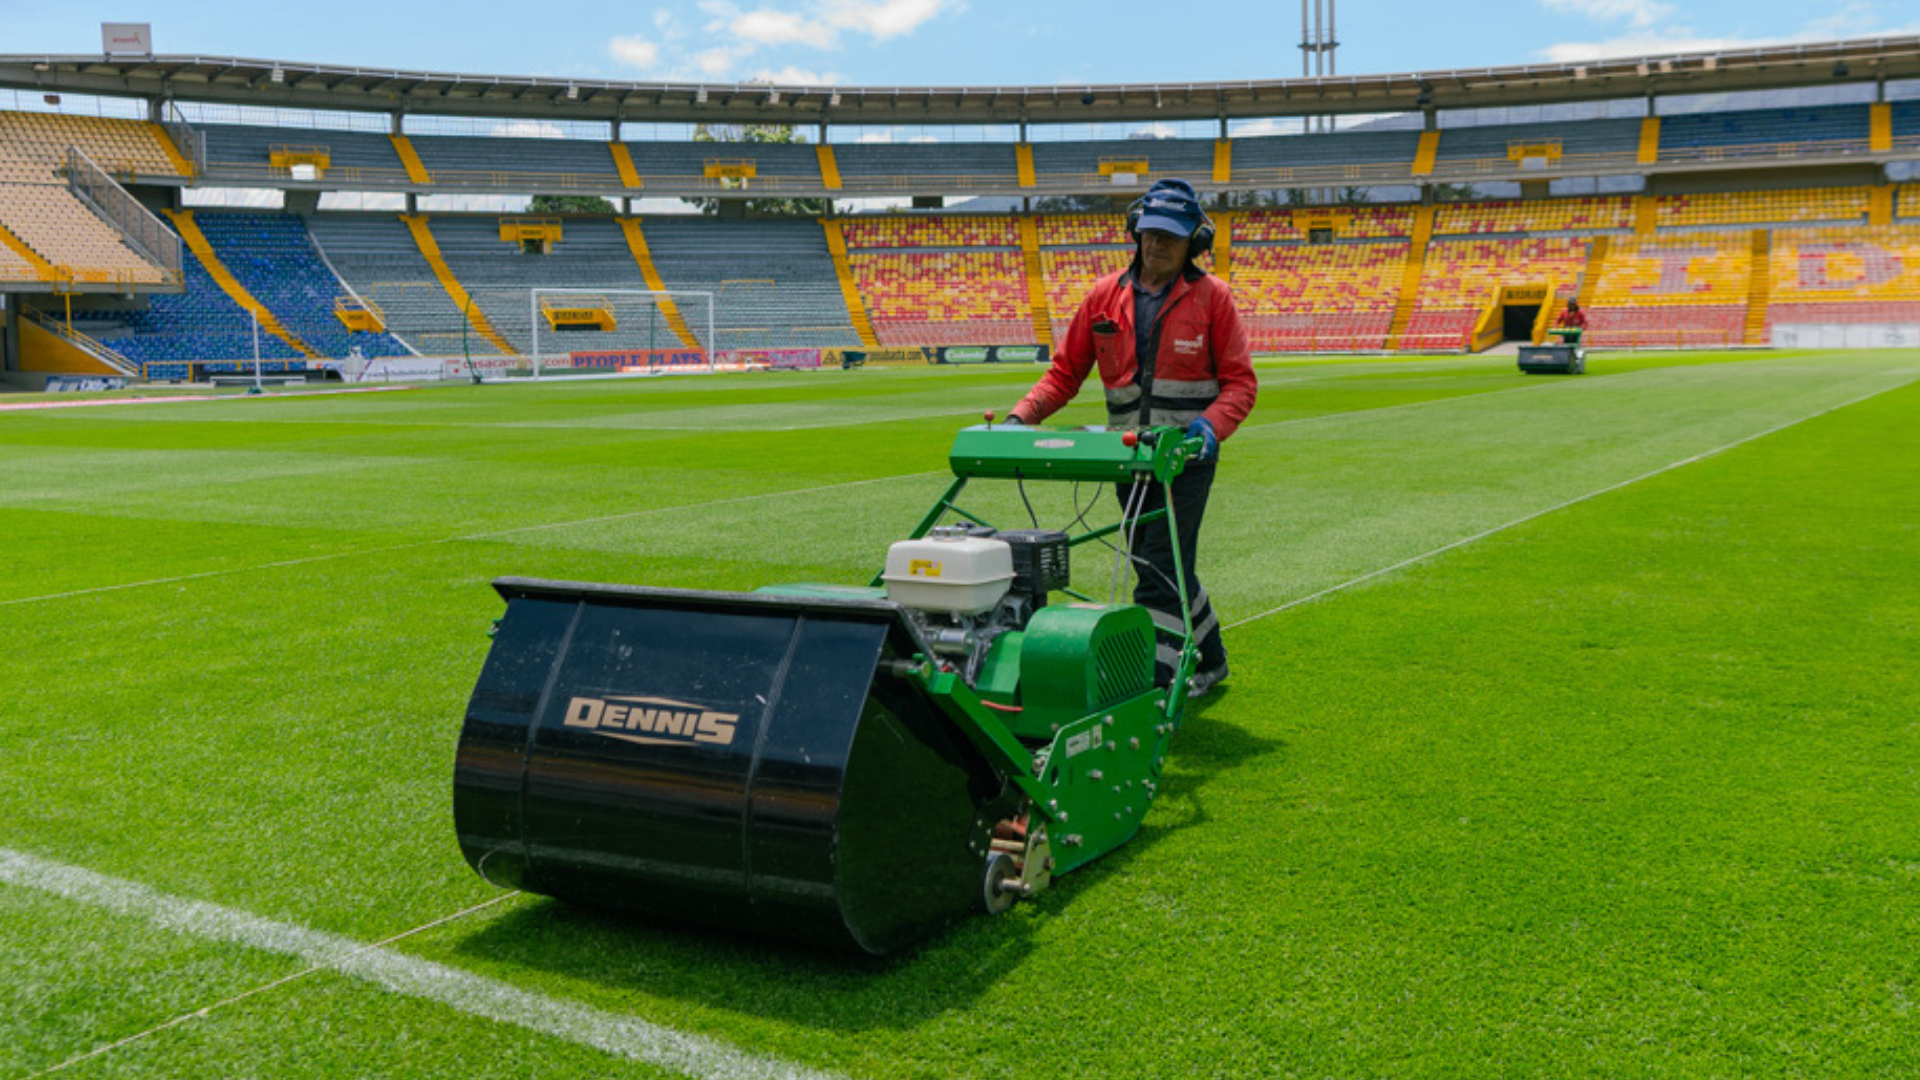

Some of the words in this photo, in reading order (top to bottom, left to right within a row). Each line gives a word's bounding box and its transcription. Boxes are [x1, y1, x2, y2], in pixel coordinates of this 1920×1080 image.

[574, 354, 641, 367] PEOPLE
[649, 353, 702, 365] PLAYS
[564, 697, 739, 745] DENNIS
